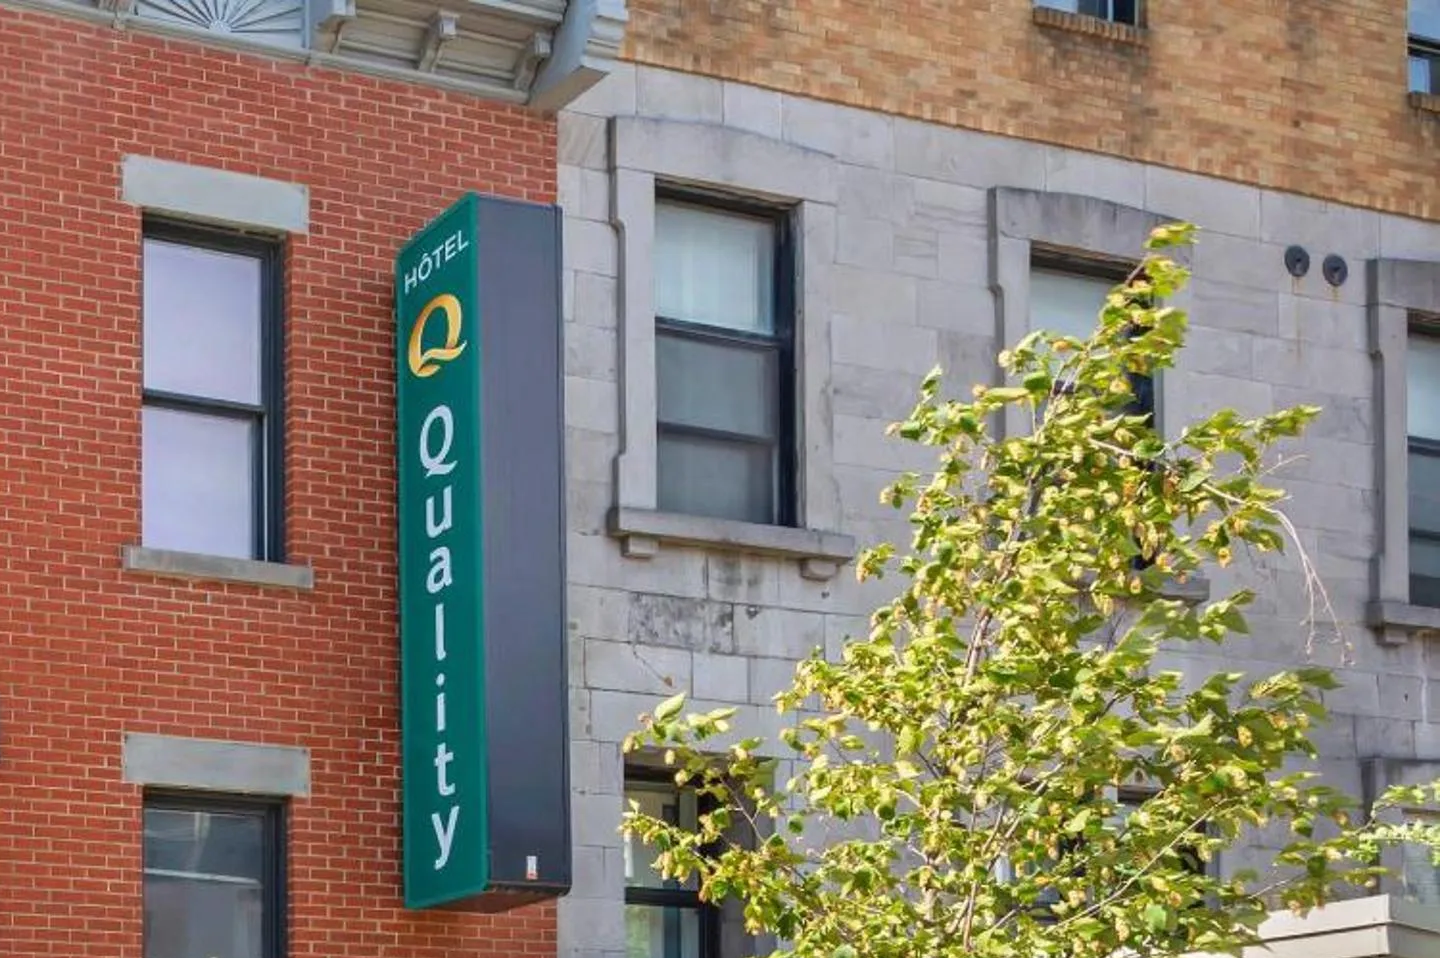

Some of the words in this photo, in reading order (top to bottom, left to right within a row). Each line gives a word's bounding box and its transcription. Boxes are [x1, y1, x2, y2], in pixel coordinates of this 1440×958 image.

[404, 230, 469, 294] HÔTEL
[408, 293, 468, 377] Q
[419, 404, 460, 871] Quality
